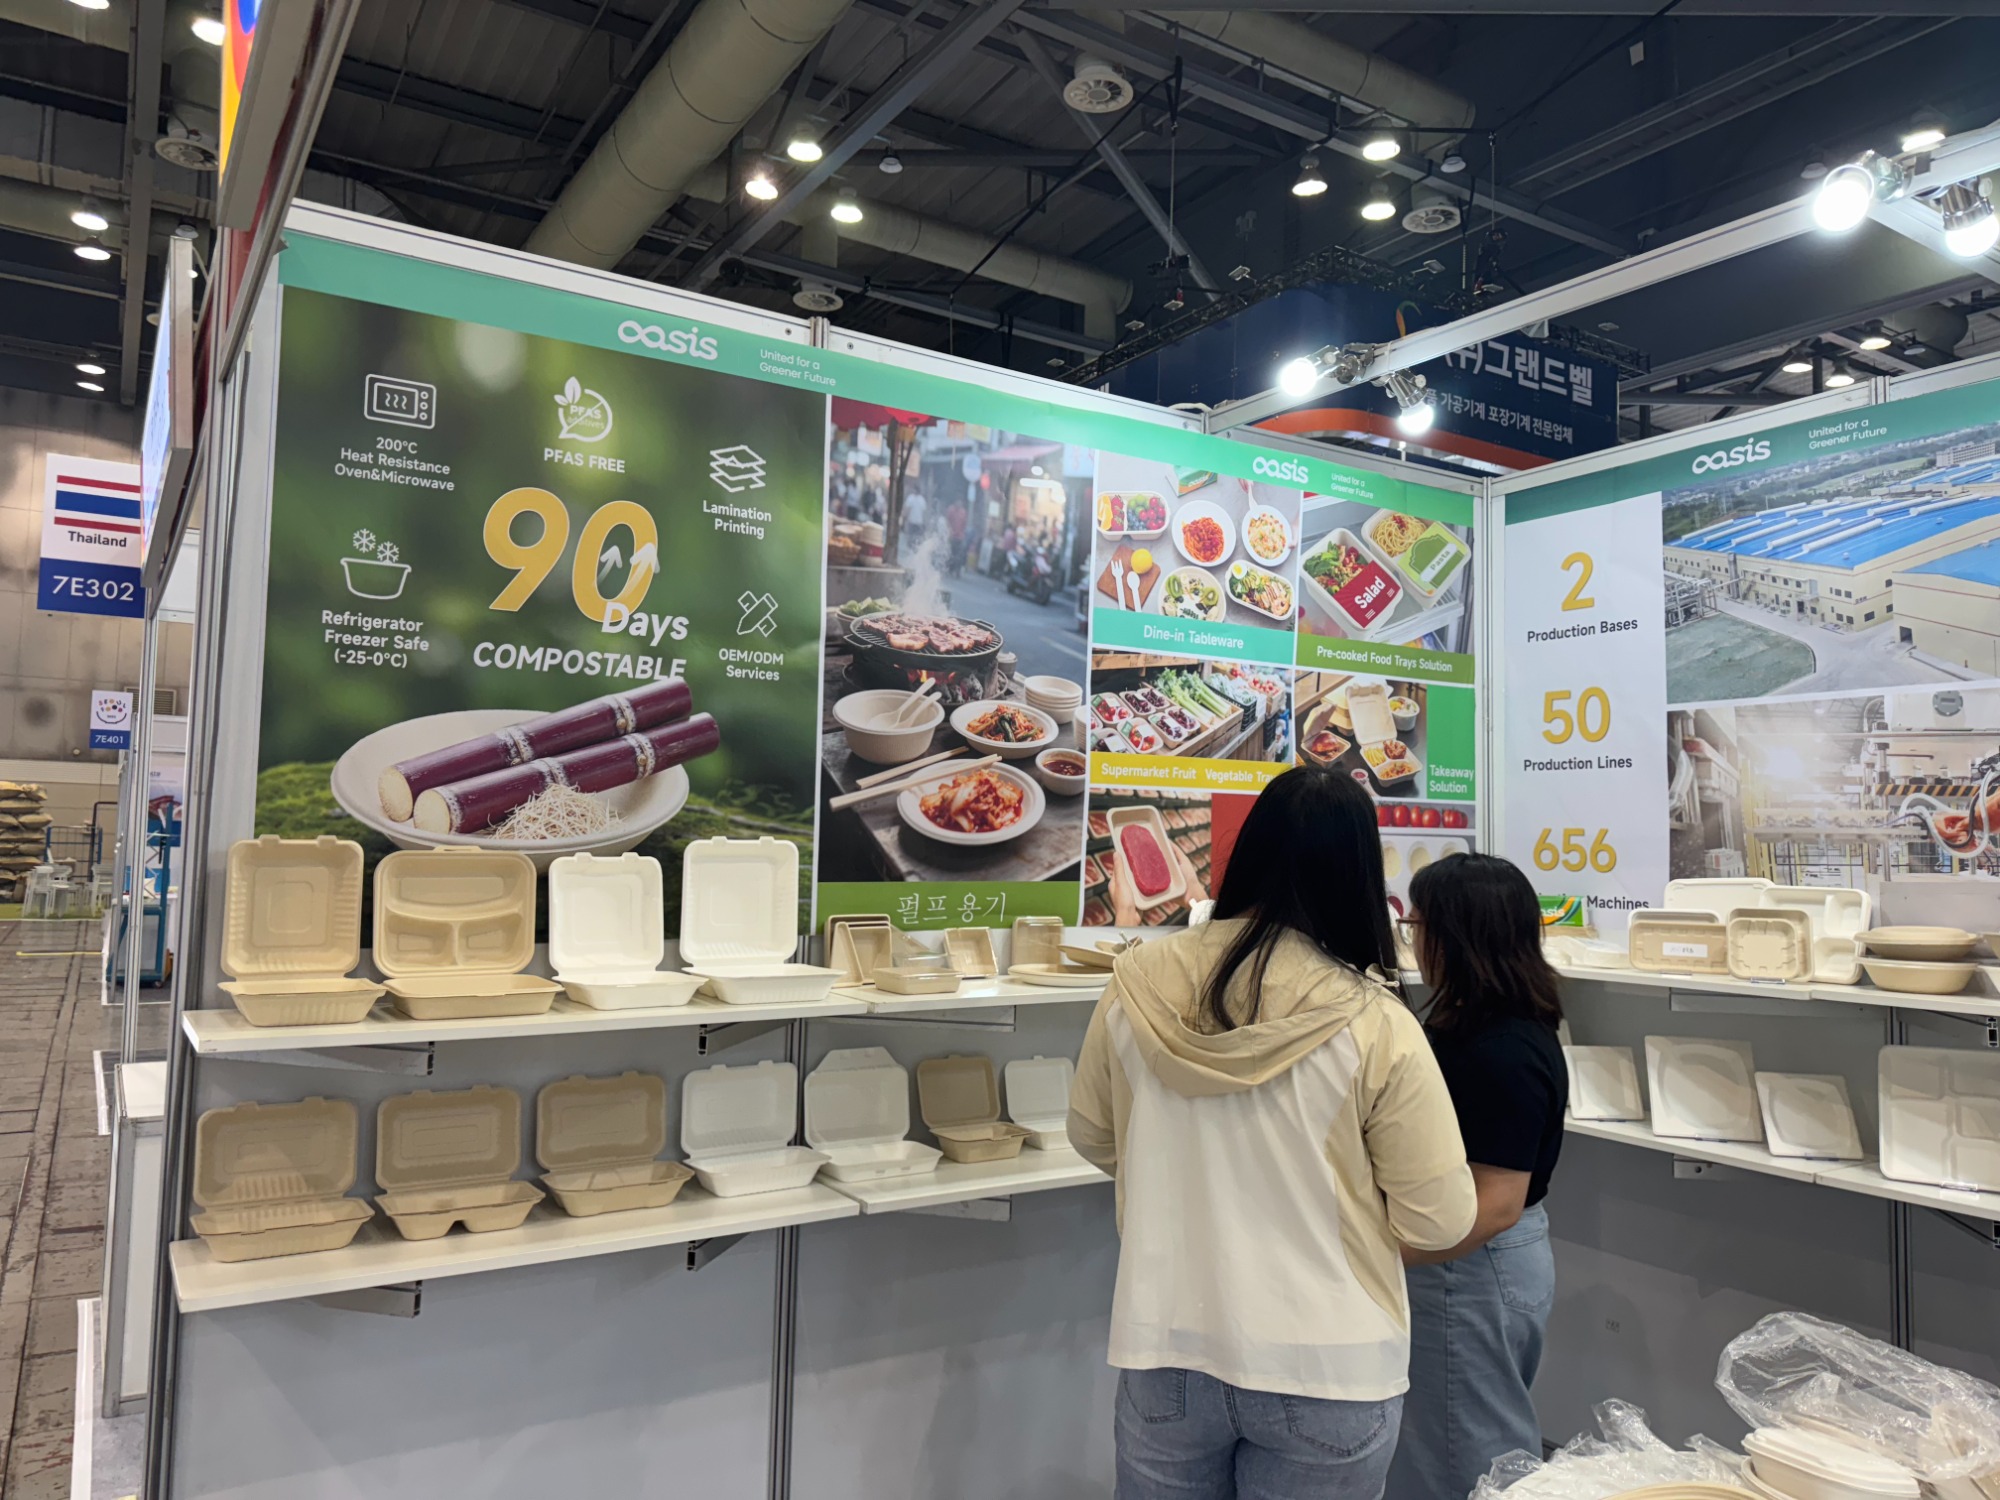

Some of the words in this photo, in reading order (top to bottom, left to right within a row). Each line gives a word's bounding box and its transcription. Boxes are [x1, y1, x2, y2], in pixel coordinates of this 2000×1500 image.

[618, 320, 719, 361] oasis
[760, 349, 794, 365] United
[796, 356, 810, 368] for
[812, 362, 820, 370] a
[759, 362, 802, 379] Greener
[804, 371, 836, 386] Future
[1440, 392, 1486, 420] 가공기계
[1488, 406, 1531, 433] 포장기계
[1532, 417, 1573, 445] 전문업체
[1808, 424, 1842, 439] United
[1844, 420, 1858, 431] for
[1861, 419, 1869, 427] a
[376, 436, 418, 454] 200°C
[1809, 434, 1850, 450] Greener
[1852, 426, 1887, 440] Future
[340, 447, 374, 464] Heat
[378, 453, 451, 475] Resistance
[544, 447, 584, 466] PFAS
[588, 454, 626, 473] FREE
[1692, 437, 1771, 475] oasis
[334, 462, 455, 491] Oven&Microwave
[1252, 456, 1309, 484] oasis
[1331, 472, 1352, 483] United
[1352, 478, 1360, 486] for
[1330, 482, 1356, 495] Greener
[1355, 488, 1374, 499] Future
[703, 499, 772, 522] Lamination
[67, 530, 127, 548] Thailand
[714, 517, 765, 540] Printing
[483, 486, 659, 623] 90
[1430, 549, 1451, 571] Pasta
[52, 575, 135, 602] 7E302
[1354, 575, 1386, 610] Salad
[1560, 551, 1595, 612] 2
[321, 609, 424, 632] Refrigerator
[601, 601, 690, 647] Days
[1527, 624, 1596, 643] Production
[1600, 619, 1639, 634] Bases
[324, 629, 389, 648] Freezer
[393, 635, 430, 651] Safe
[1143, 624, 1185, 642] Dine-in
[1188, 630, 1244, 649] Tableware
[473, 641, 687, 681] COMPOSTABLE
[718, 648, 784, 665] OEM/ODM
[1316, 645, 1368, 663] Pre-cooked
[1370, 652, 1392, 666] Food
[1394, 655, 1417, 670] Trays
[1418, 658, 1453, 673] Solution
[726, 665, 780, 681] Services
[1542, 686, 1611, 745] 50
[94, 734, 124, 745] 7E401
[1101, 763, 1169, 779] Supermarket
[1172, 767, 1197, 780] Fruit
[1205, 768, 1254, 784] Vegetable
[1429, 764, 1475, 782] Takeaway
[1524, 757, 1593, 772] Production
[1597, 755, 1633, 769] Lines
[1429, 779, 1468, 794] Solution
[1533, 827, 1617, 874] 656
[957, 892, 1006, 923] 용기
[1586, 895, 1650, 911] Machines
